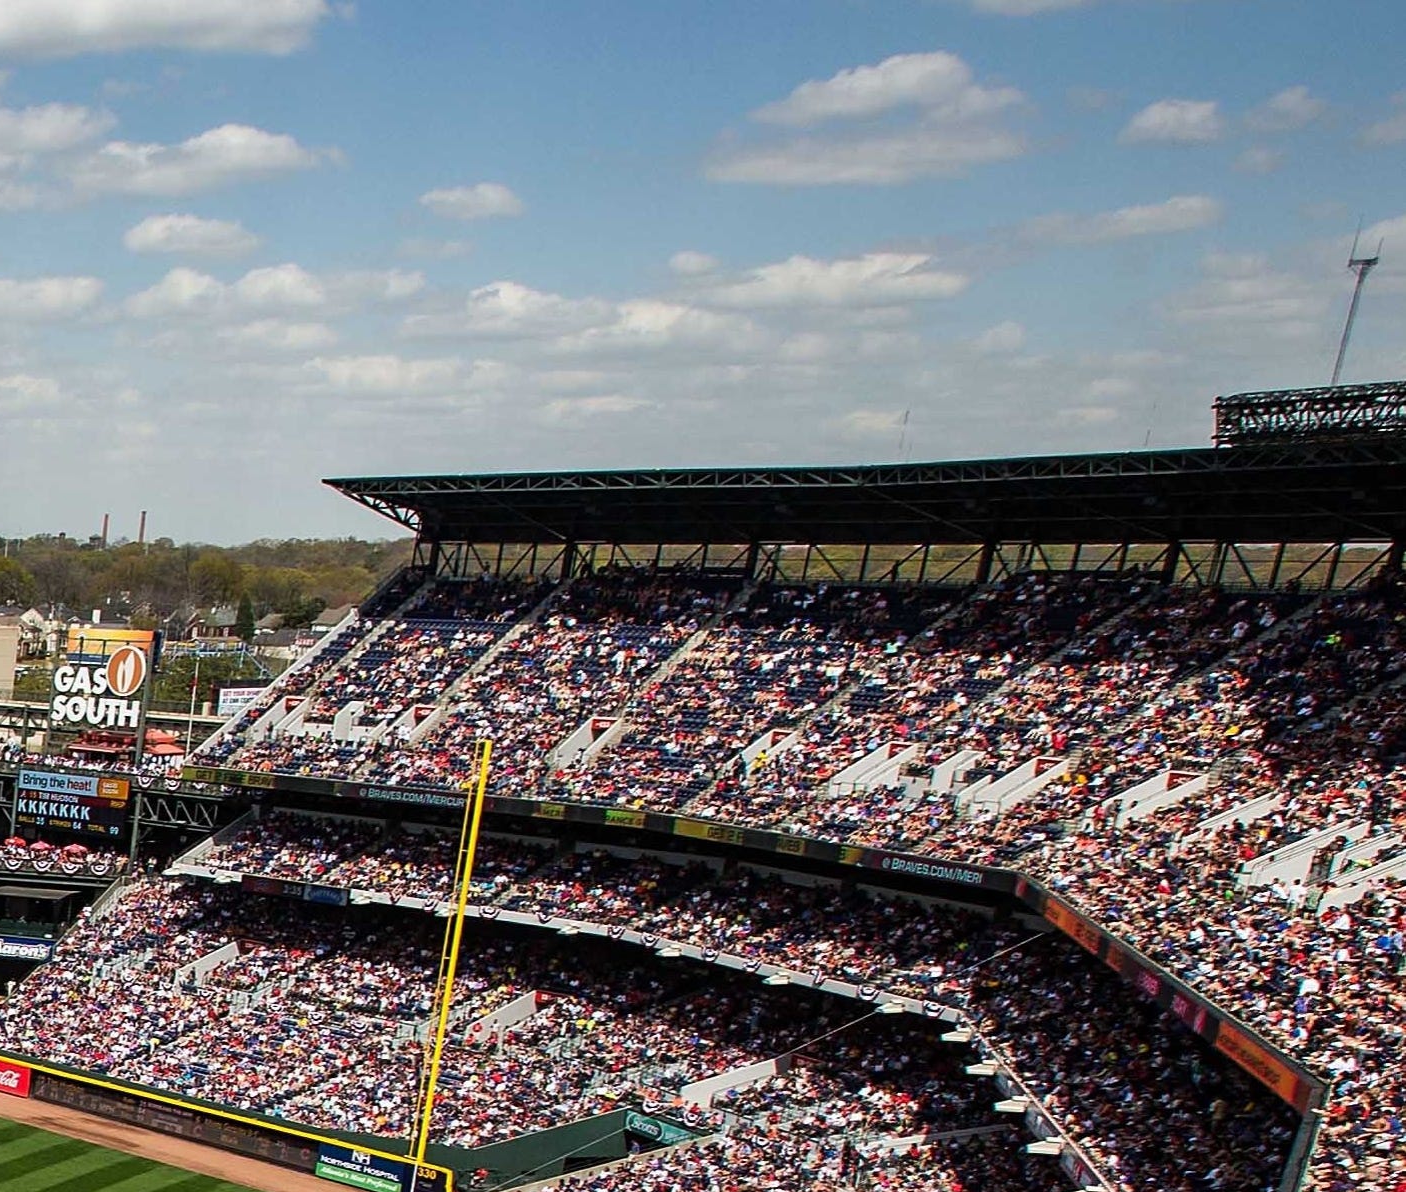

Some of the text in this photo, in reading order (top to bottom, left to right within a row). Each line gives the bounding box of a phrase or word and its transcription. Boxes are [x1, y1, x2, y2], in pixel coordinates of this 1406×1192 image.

[54, 665, 108, 694] GAS
[51, 695, 140, 728] SOUTH
[23, 774, 92, 791] Bring the heat!
[369, 788, 466, 807] BRAVES.COM/MERCUR
[320, 1155, 400, 1181] NORTHSIDE HOSPITAL
[417, 1167, 437, 1179] 330
